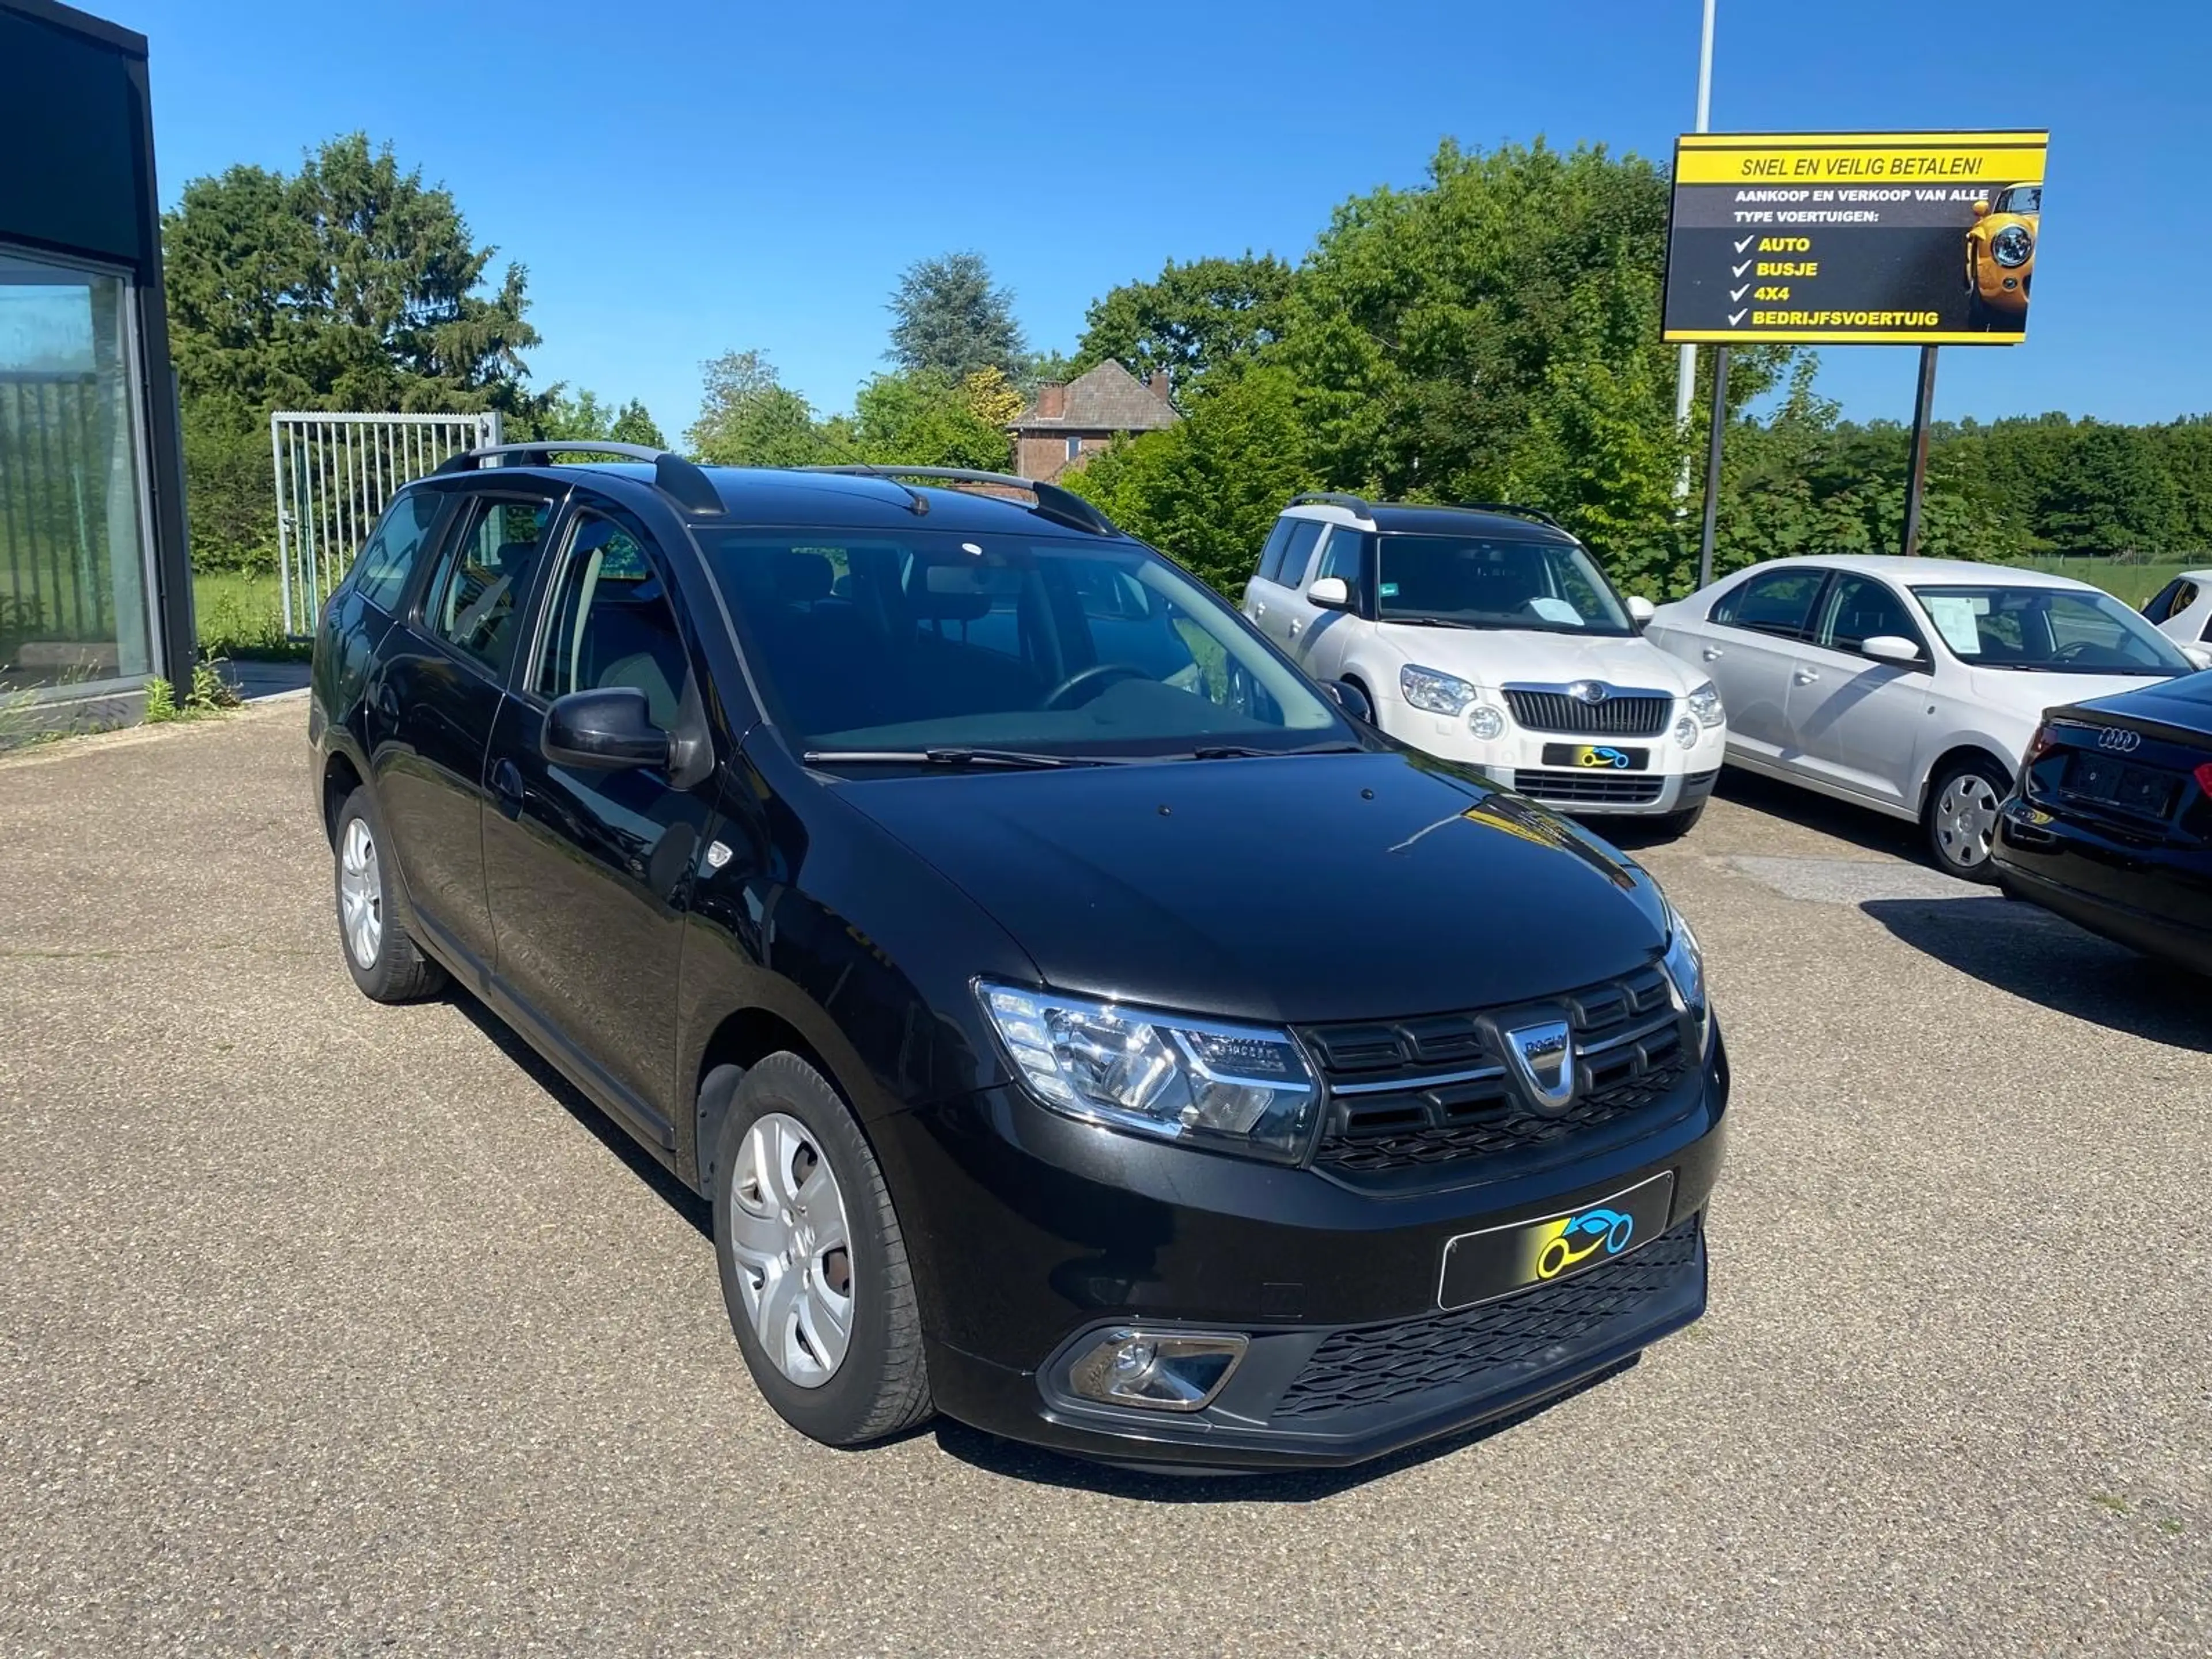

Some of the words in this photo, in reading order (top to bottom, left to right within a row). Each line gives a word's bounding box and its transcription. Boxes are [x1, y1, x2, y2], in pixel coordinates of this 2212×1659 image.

[1741, 159, 1788, 176] SNEL
[1793, 159, 1820, 175] EN
[1826, 158, 1885, 175] VEILIG
[1890, 157, 1983, 175] BETALEN!
[1734, 190, 1809, 202] AANKOOP
[1812, 190, 1834, 201] EN
[1838, 190, 1911, 201] VERKOOP
[1914, 190, 1946, 201] VAN
[1949, 190, 1989, 200] ALLE
[1734, 211, 1773, 222] TYPE
[1776, 211, 1880, 222] VOERTUIGEN:
[1758, 238, 1810, 252] AUTO
[1756, 263, 1818, 276] BUSJE
[1754, 287, 1790, 301] 4X4
[1752, 311, 1939, 325] BEDRIJFSVOERTUIG
